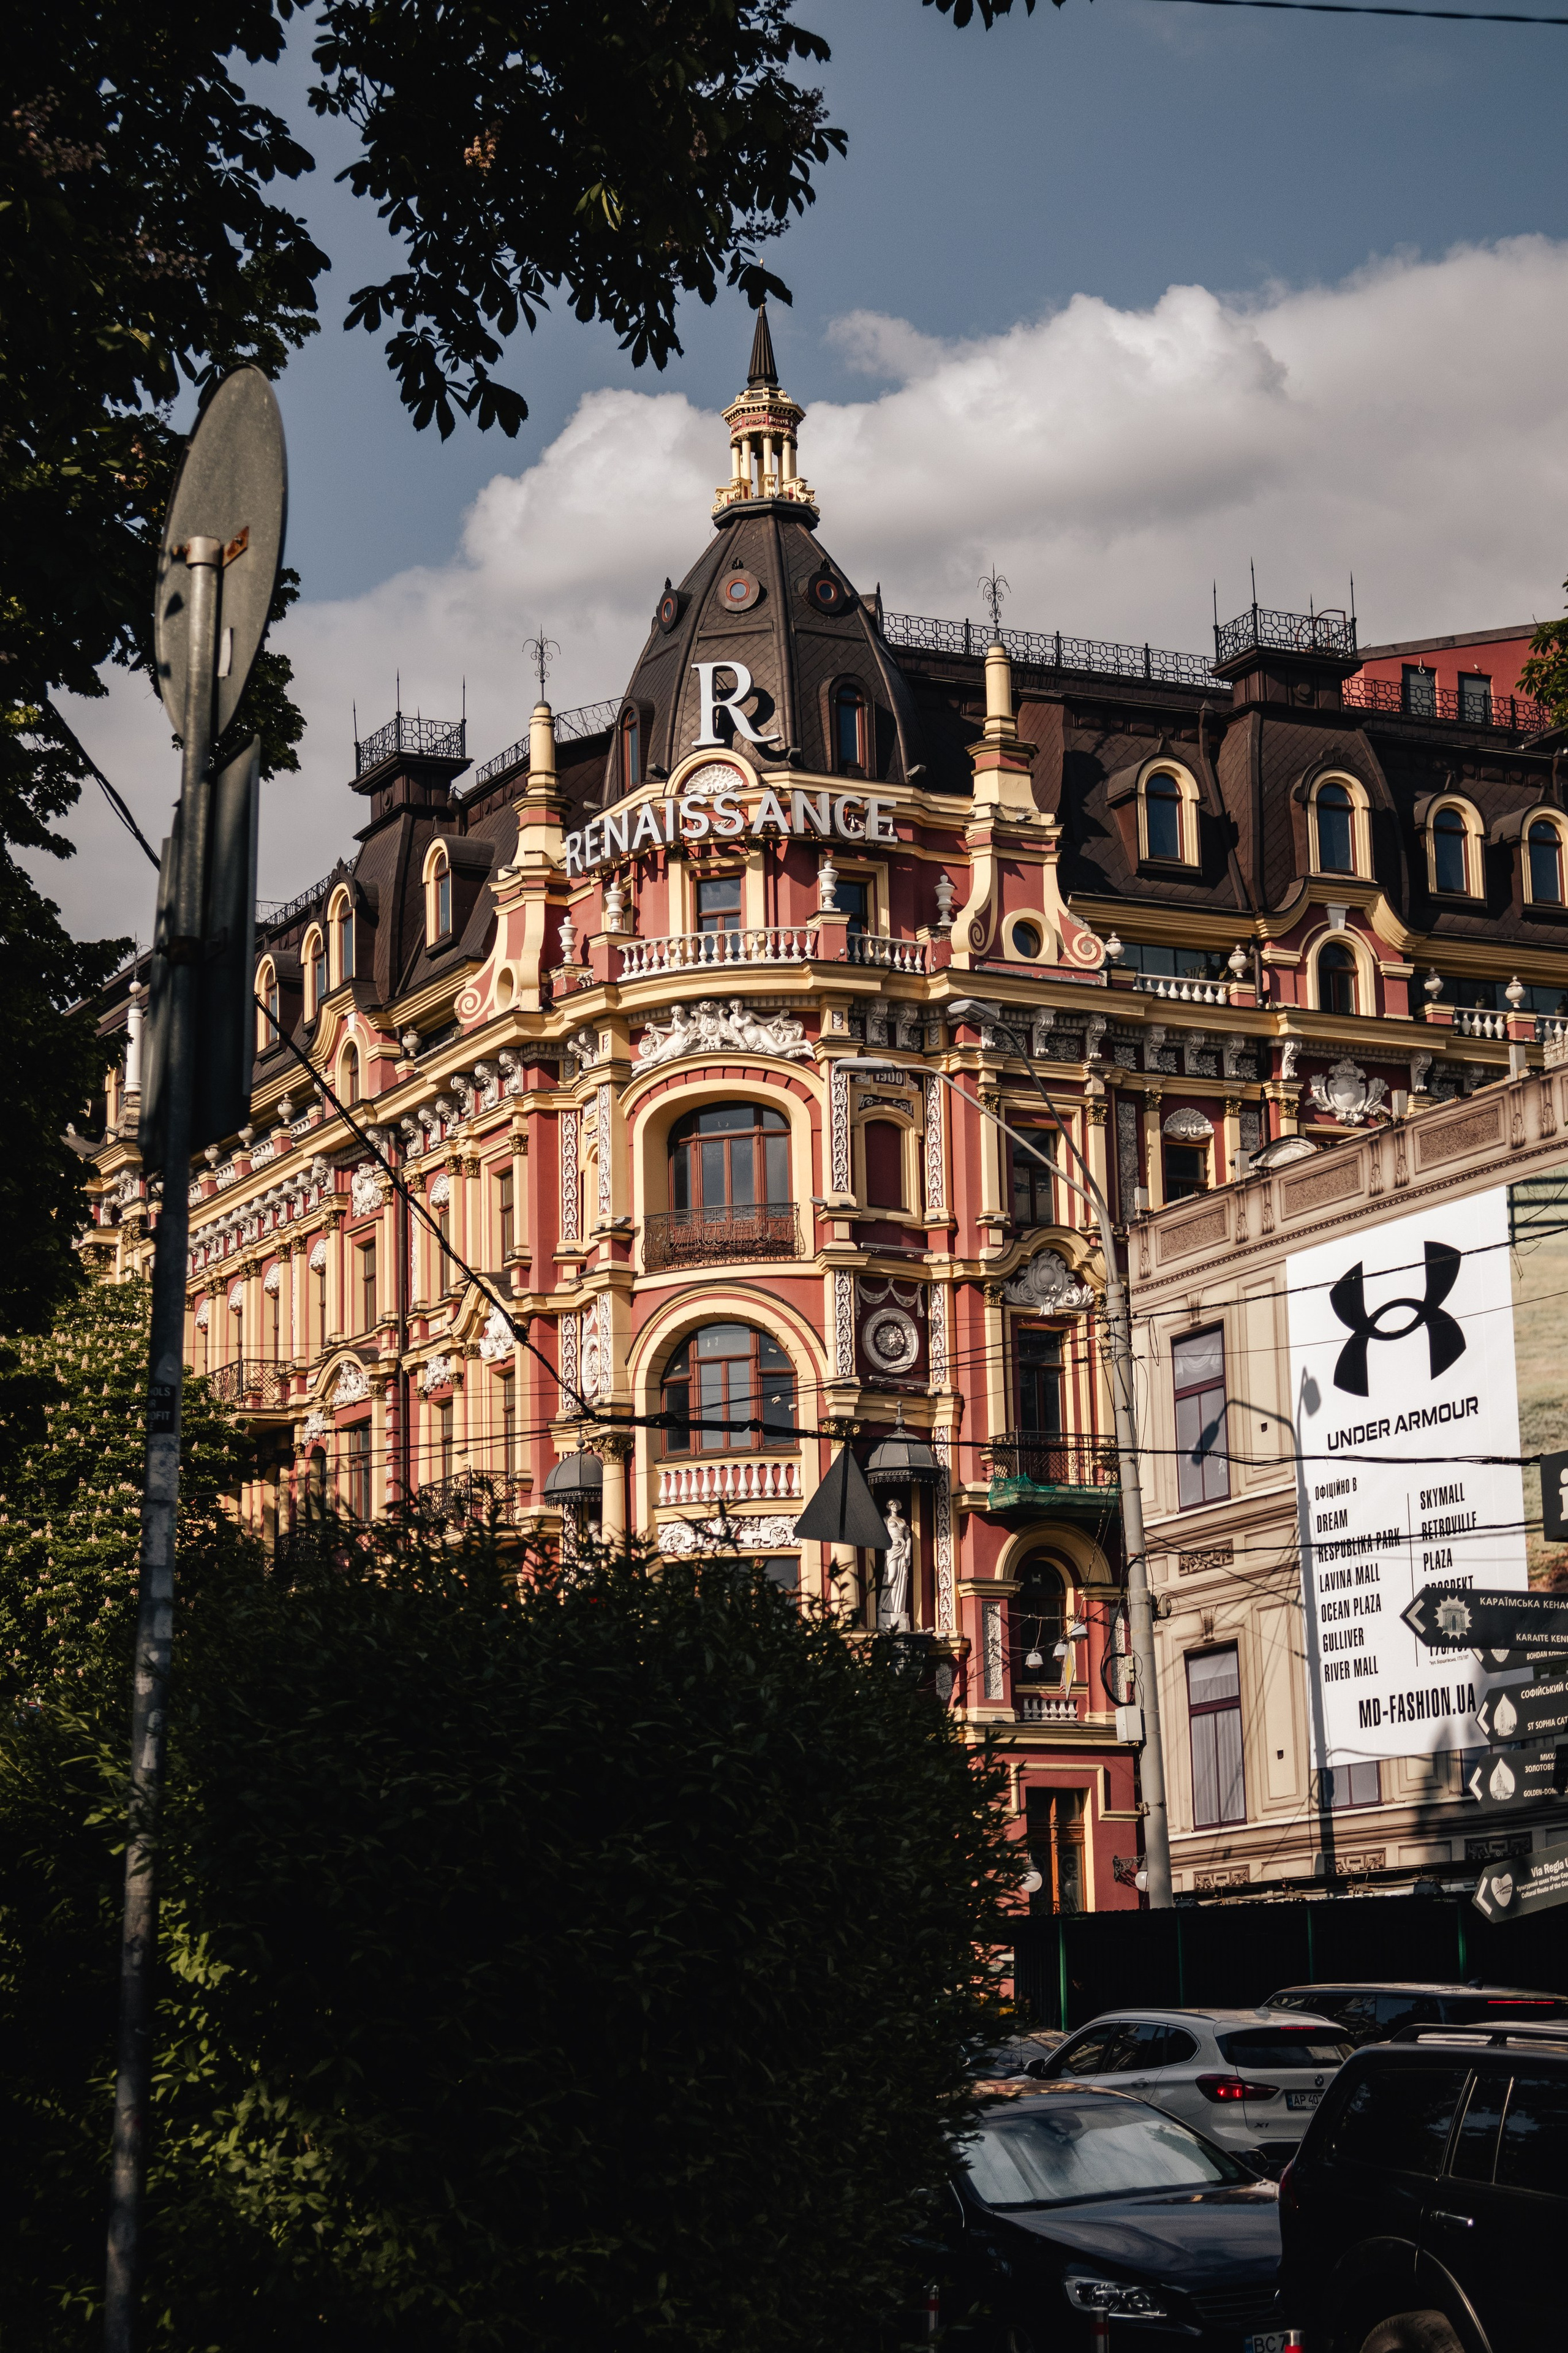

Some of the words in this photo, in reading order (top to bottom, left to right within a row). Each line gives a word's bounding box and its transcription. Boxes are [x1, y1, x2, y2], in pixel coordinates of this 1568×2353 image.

[692, 661, 780, 747] R
[565, 790, 899, 878] RENAISSANCE
[1327, 1418, 1390, 1451] UNDER
[1395, 1396, 1479, 1435] ARMOUR
[1315, 1478, 1350, 1501] ОФІЦІЙНО
[1352, 1477, 1357, 1492] В
[1420, 1482, 1465, 1510] SKYMALL
[1317, 1508, 1348, 1533] DREAM
[1422, 1511, 1477, 1541] RETROVILLE
[1318, 1533, 1373, 1563] RESPUBLIKA
[1376, 1527, 1401, 1550] PARK
[1423, 1548, 1453, 1572] PLAZA
[1319, 1569, 1352, 1593] LAVINA
[1355, 1563, 1381, 1586] MALL
[1321, 1599, 1350, 1623] OCEAN
[1353, 1593, 1382, 1617] PLAZA
[1480, 1596, 1540, 1608] КАРАЇМСЬКА
[1322, 1627, 1365, 1653] GULLIVER
[1516, 1633, 1548, 1642] KARAITE
[1526, 1650, 1548, 1660] BOHDAN
[1324, 1660, 1351, 1683] RIVER
[1354, 1655, 1379, 1678] MALL
[1521, 1681, 1564, 1699] СОФІЙСЬКИЙ
[1359, 1682, 1477, 1729] MD-FASHION.UA
[1527, 1721, 1534, 1731] ST
[1535, 1718, 1556, 1730] SOPHIA
[1531, 1866, 1544, 1878] Via
[1544, 1859, 1564, 1874] Regia
[1521, 1889, 1537, 1899] Cultural
[1294, 2094, 1306, 2105] AP
[1254, 2335, 1276, 2353] BC
